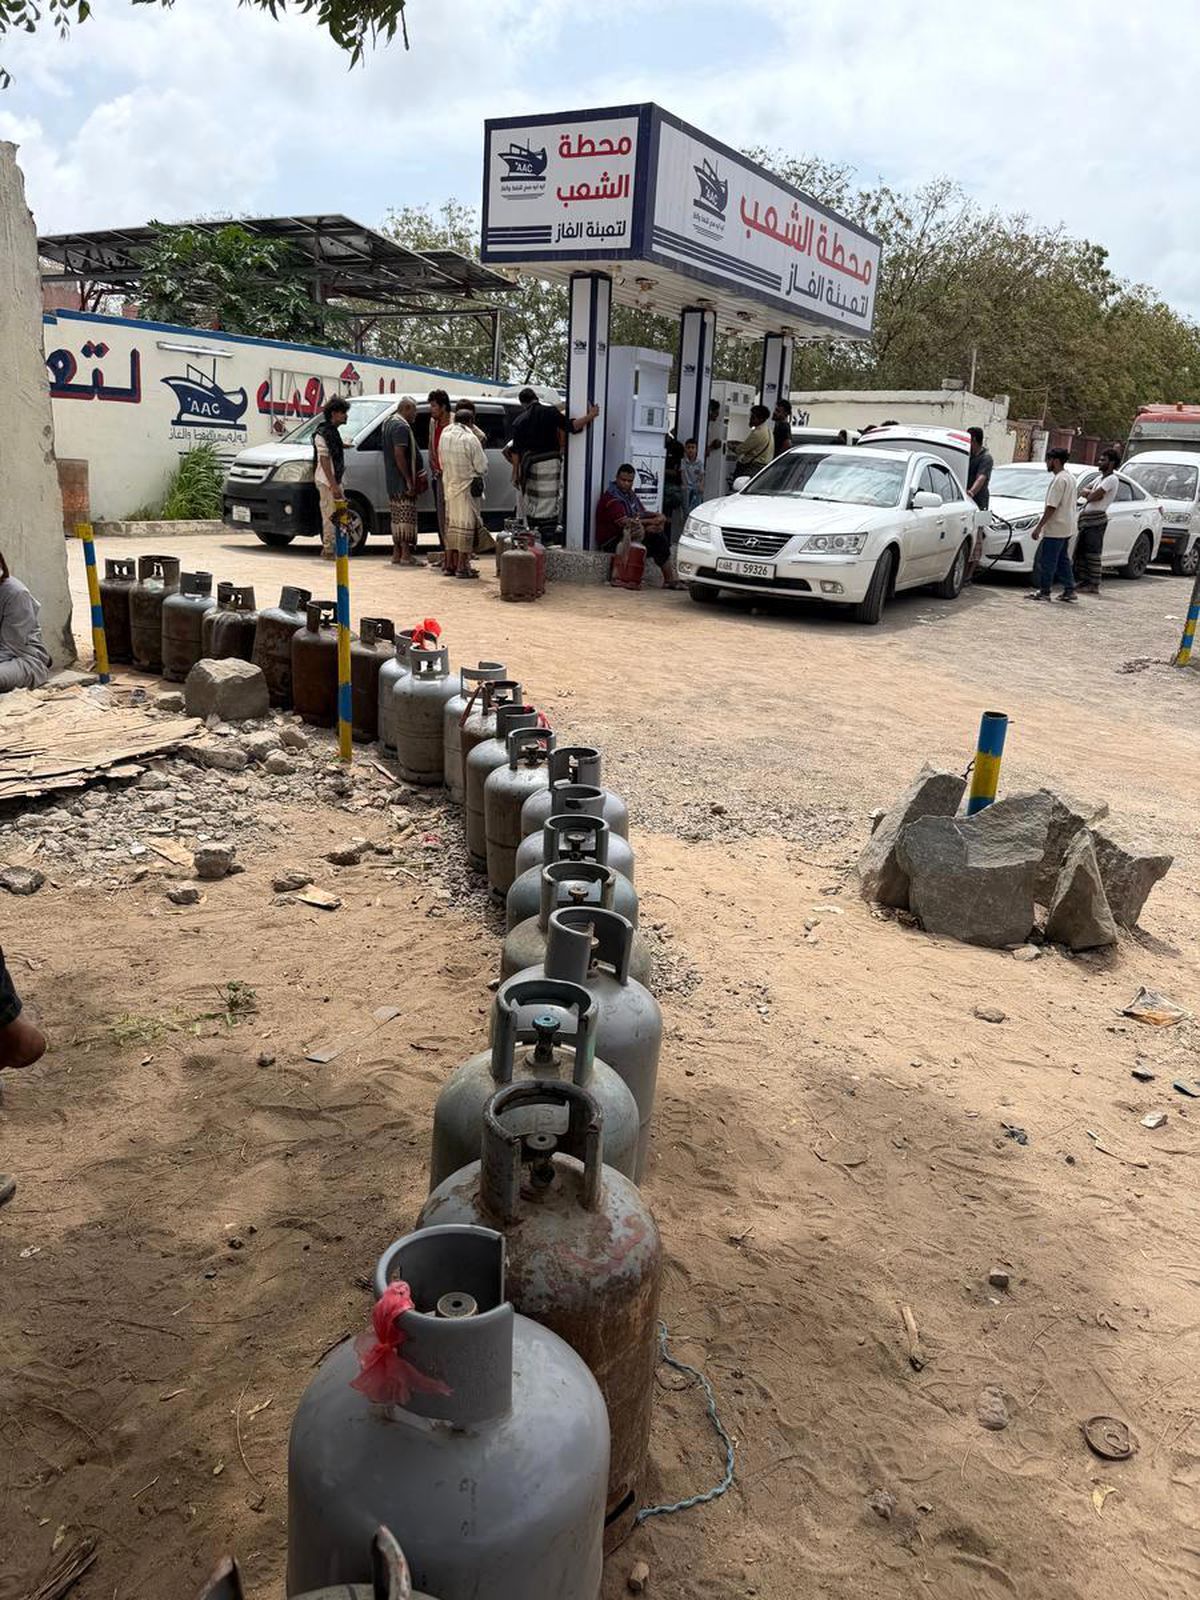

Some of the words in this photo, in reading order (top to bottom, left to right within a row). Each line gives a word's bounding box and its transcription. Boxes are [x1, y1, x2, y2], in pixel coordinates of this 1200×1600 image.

[558, 134, 632, 158] محطة
[556, 171, 630, 208] الشعب
[554, 221, 583, 243] الغاز
[585, 220, 626, 242] لتعبئة
[740, 195, 815, 257] الشعب
[816, 224, 872, 286] محطة
[785, 262, 825, 302] الغاز
[826, 279, 869, 319] لتعبئة
[190, 400, 221, 416] AAC
[743, 563, 768, 576] 59326
